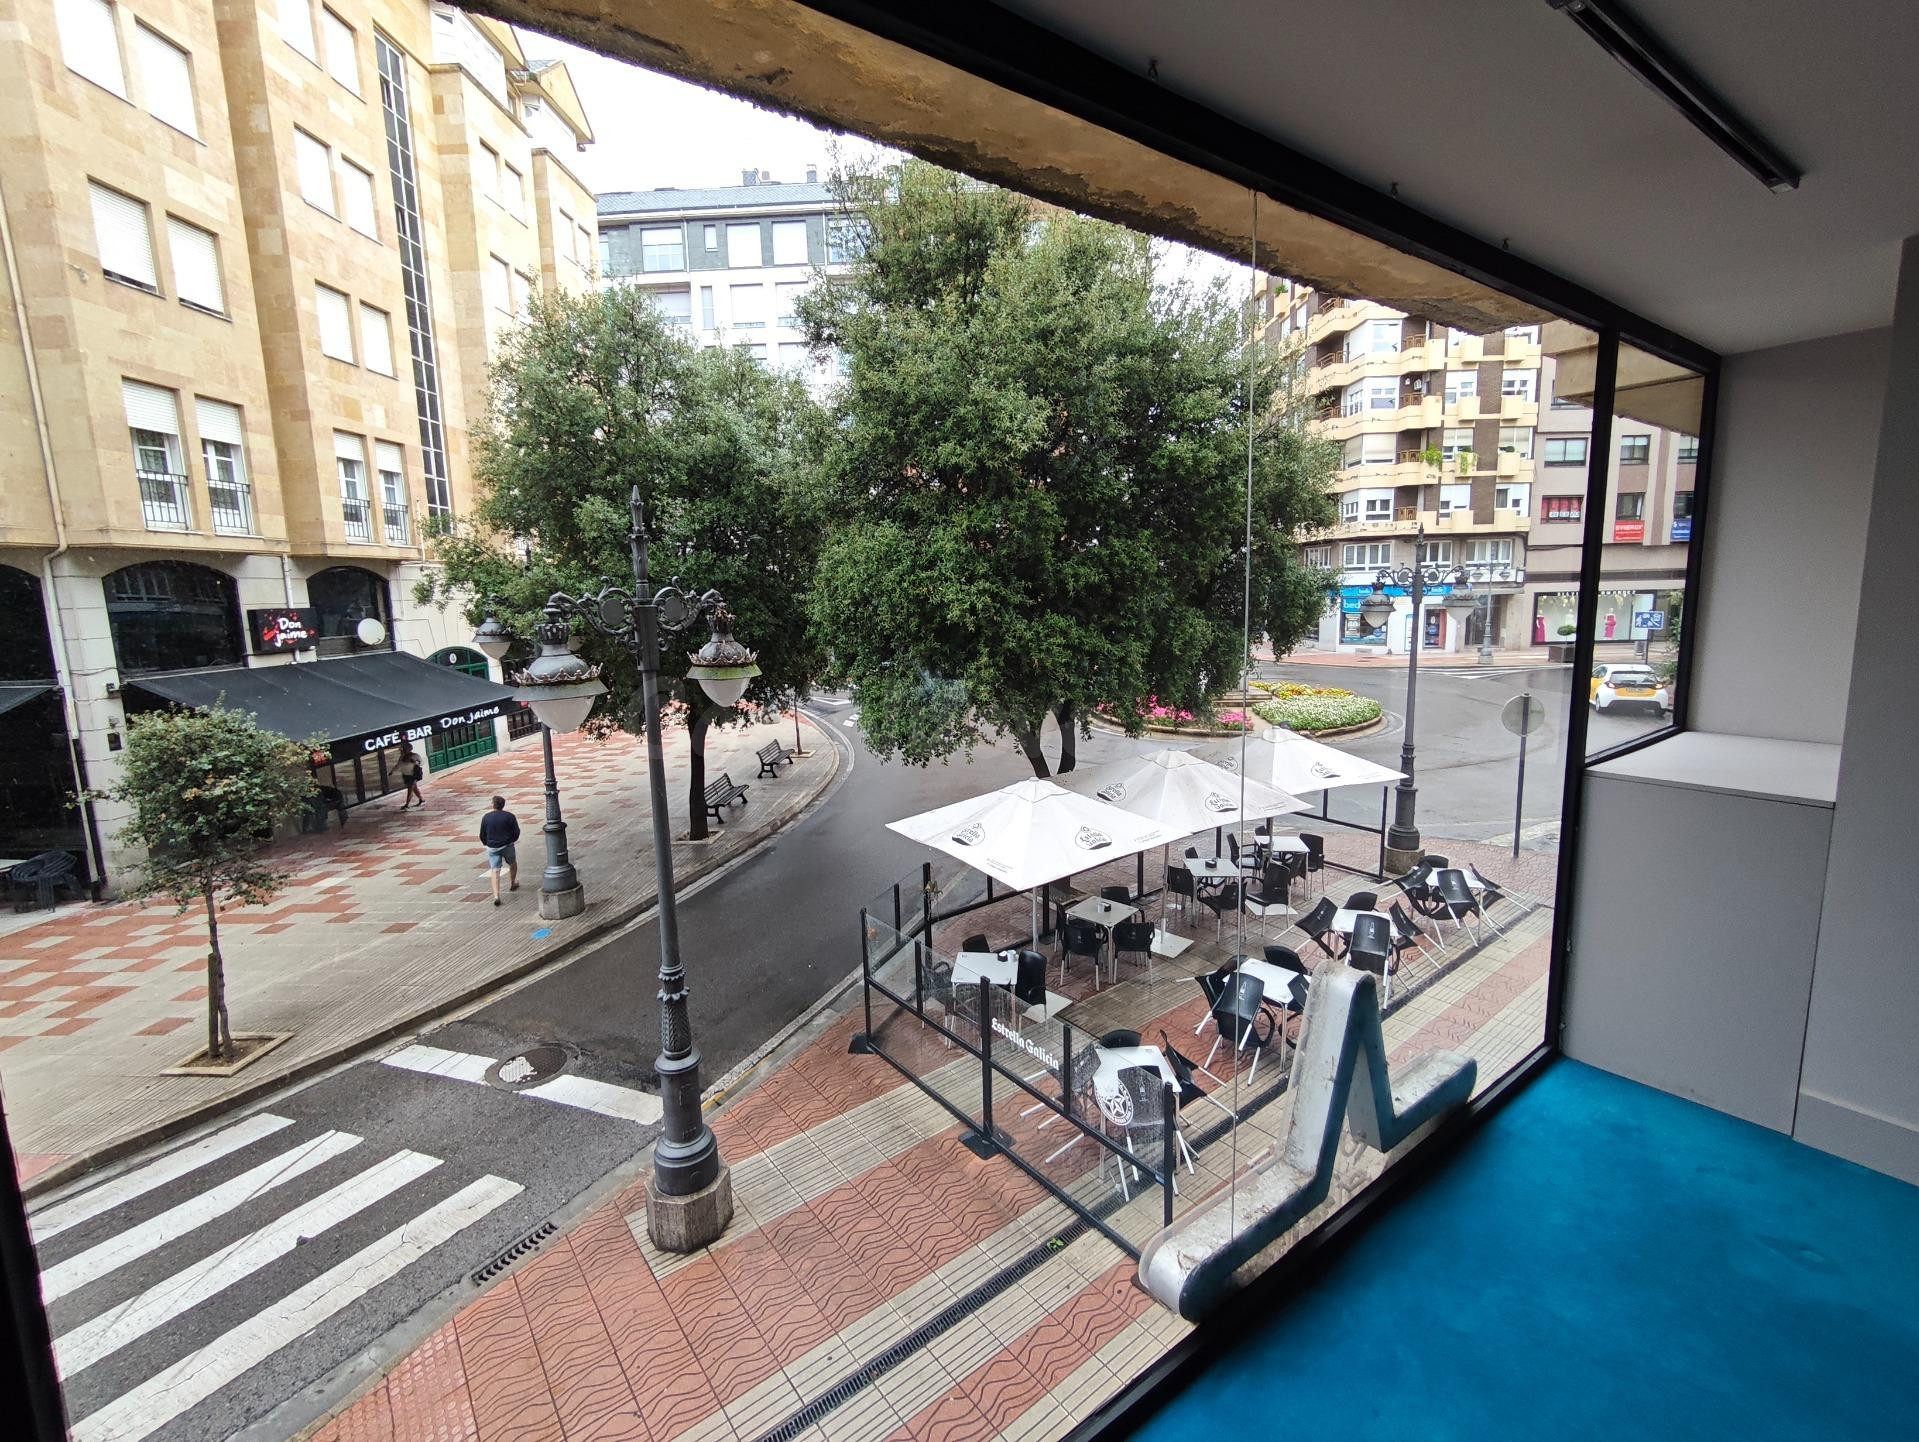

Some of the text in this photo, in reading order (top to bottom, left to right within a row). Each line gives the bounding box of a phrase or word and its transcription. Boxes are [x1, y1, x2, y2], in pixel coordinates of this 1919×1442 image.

[277, 617, 302, 630] Don
[440, 715, 466, 729] Don
[364, 724, 433, 751] CAFÉ BAR
[991, 1017, 1060, 1071] Estrella Galicia
